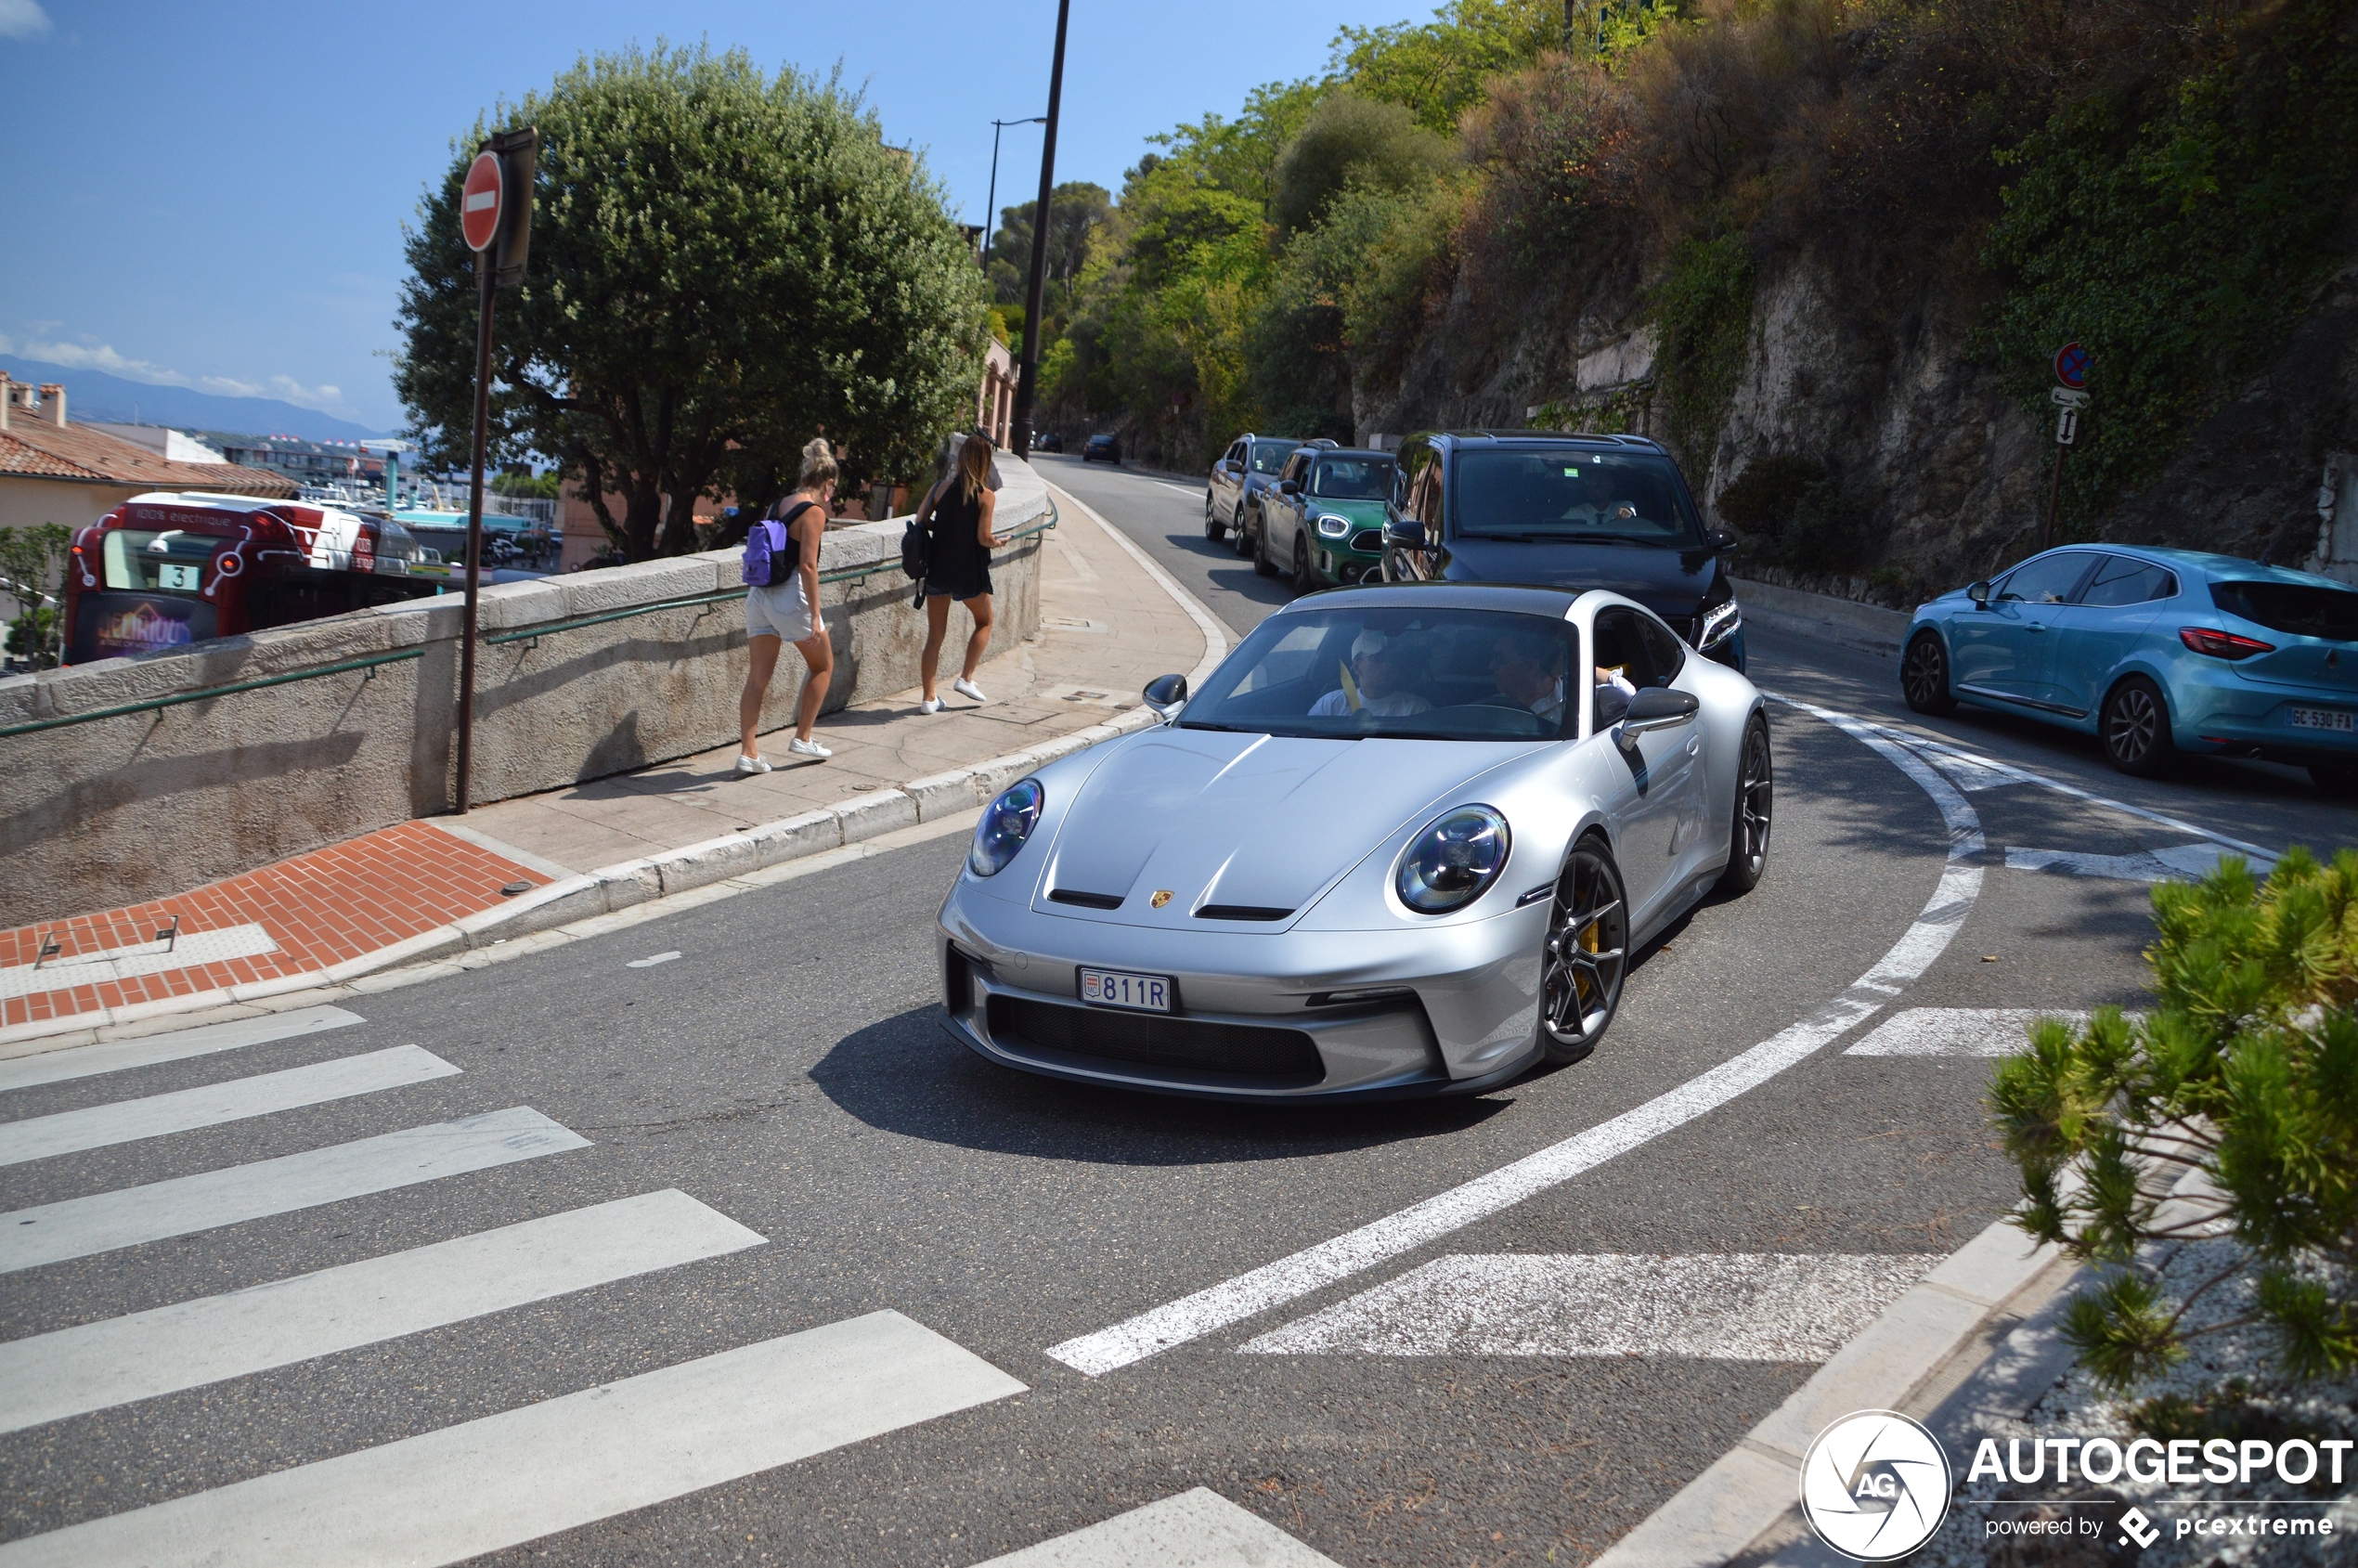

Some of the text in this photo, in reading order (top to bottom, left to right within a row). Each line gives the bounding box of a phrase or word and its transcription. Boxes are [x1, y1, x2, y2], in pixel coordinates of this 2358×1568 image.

[136, 508, 232, 526] 100% électrique
[172, 566, 185, 588] 3
[1104, 976, 1164, 1006] 811R
